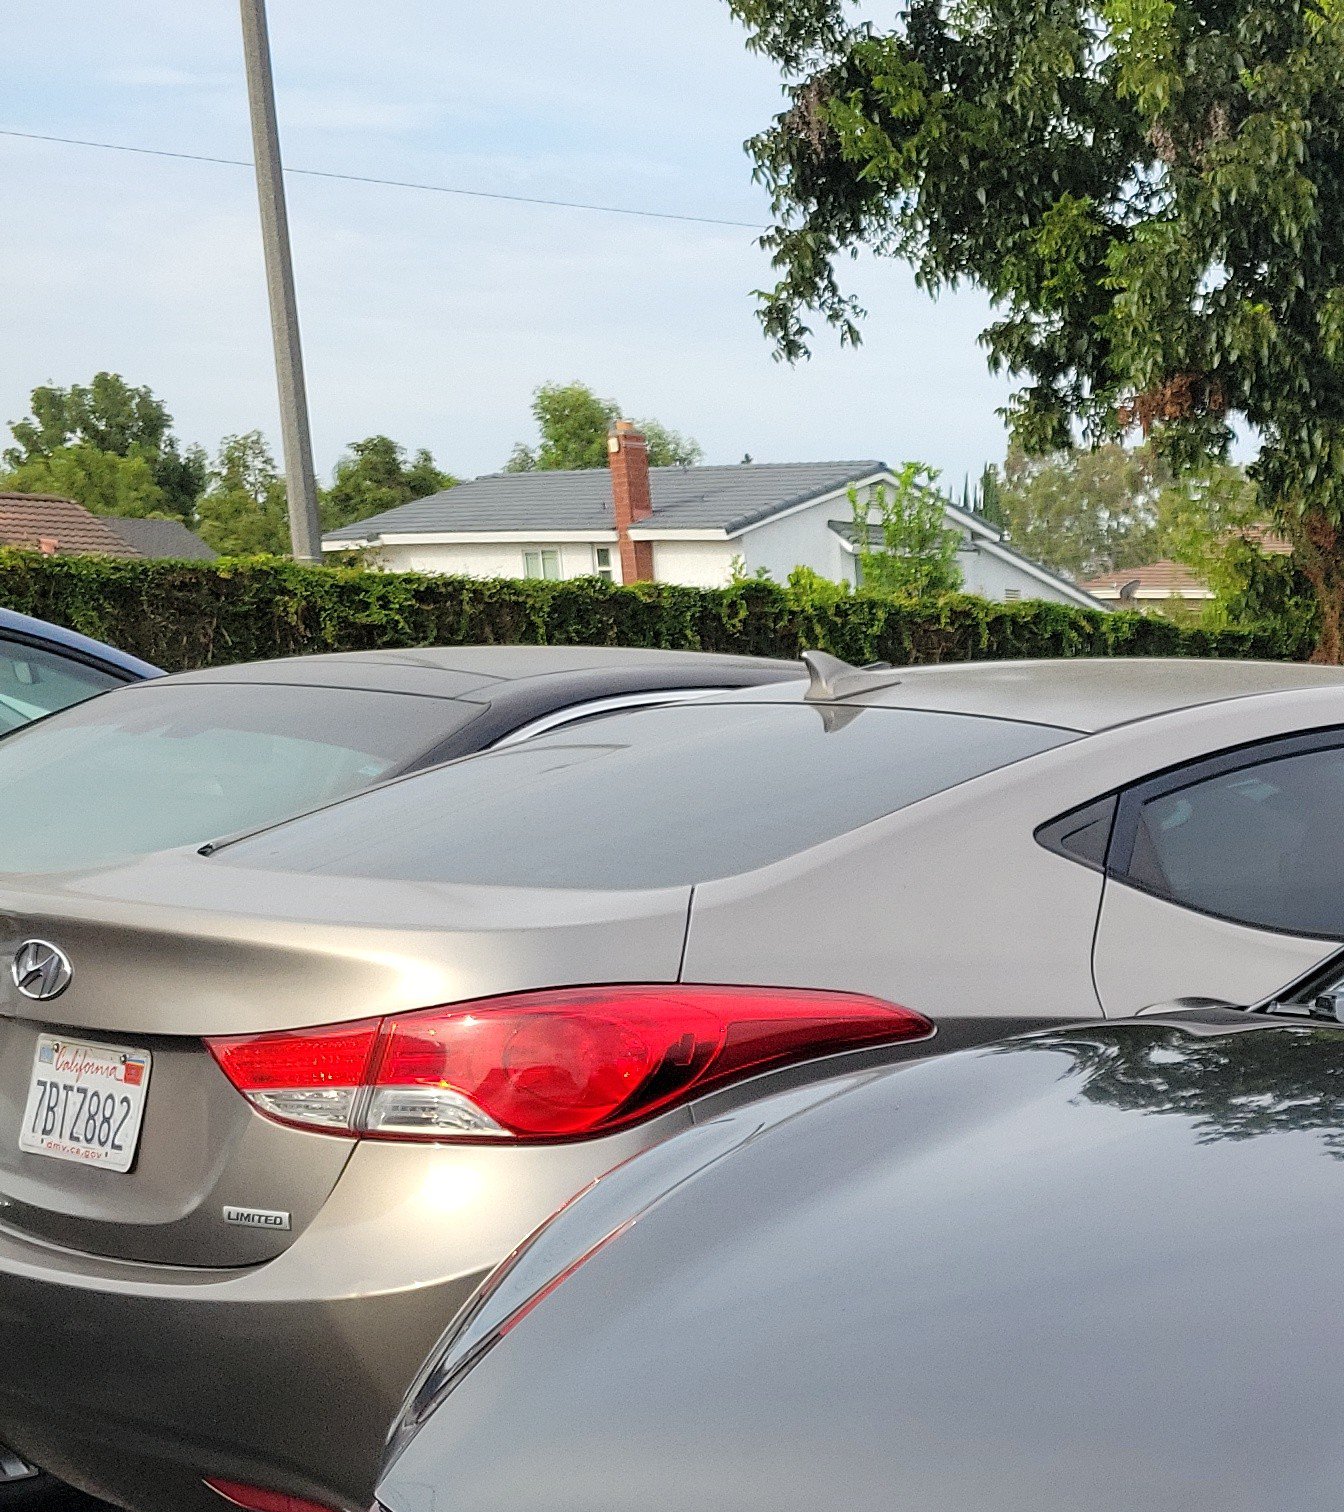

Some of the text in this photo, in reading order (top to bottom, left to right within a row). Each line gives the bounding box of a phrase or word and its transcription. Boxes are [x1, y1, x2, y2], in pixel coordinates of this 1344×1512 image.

[55, 1047, 123, 1083] California
[32, 1080, 131, 1151] 7BTZ882
[46, 1141, 102, 1159] dmv.ca.gov
[228, 1211, 283, 1226] LIMITED
